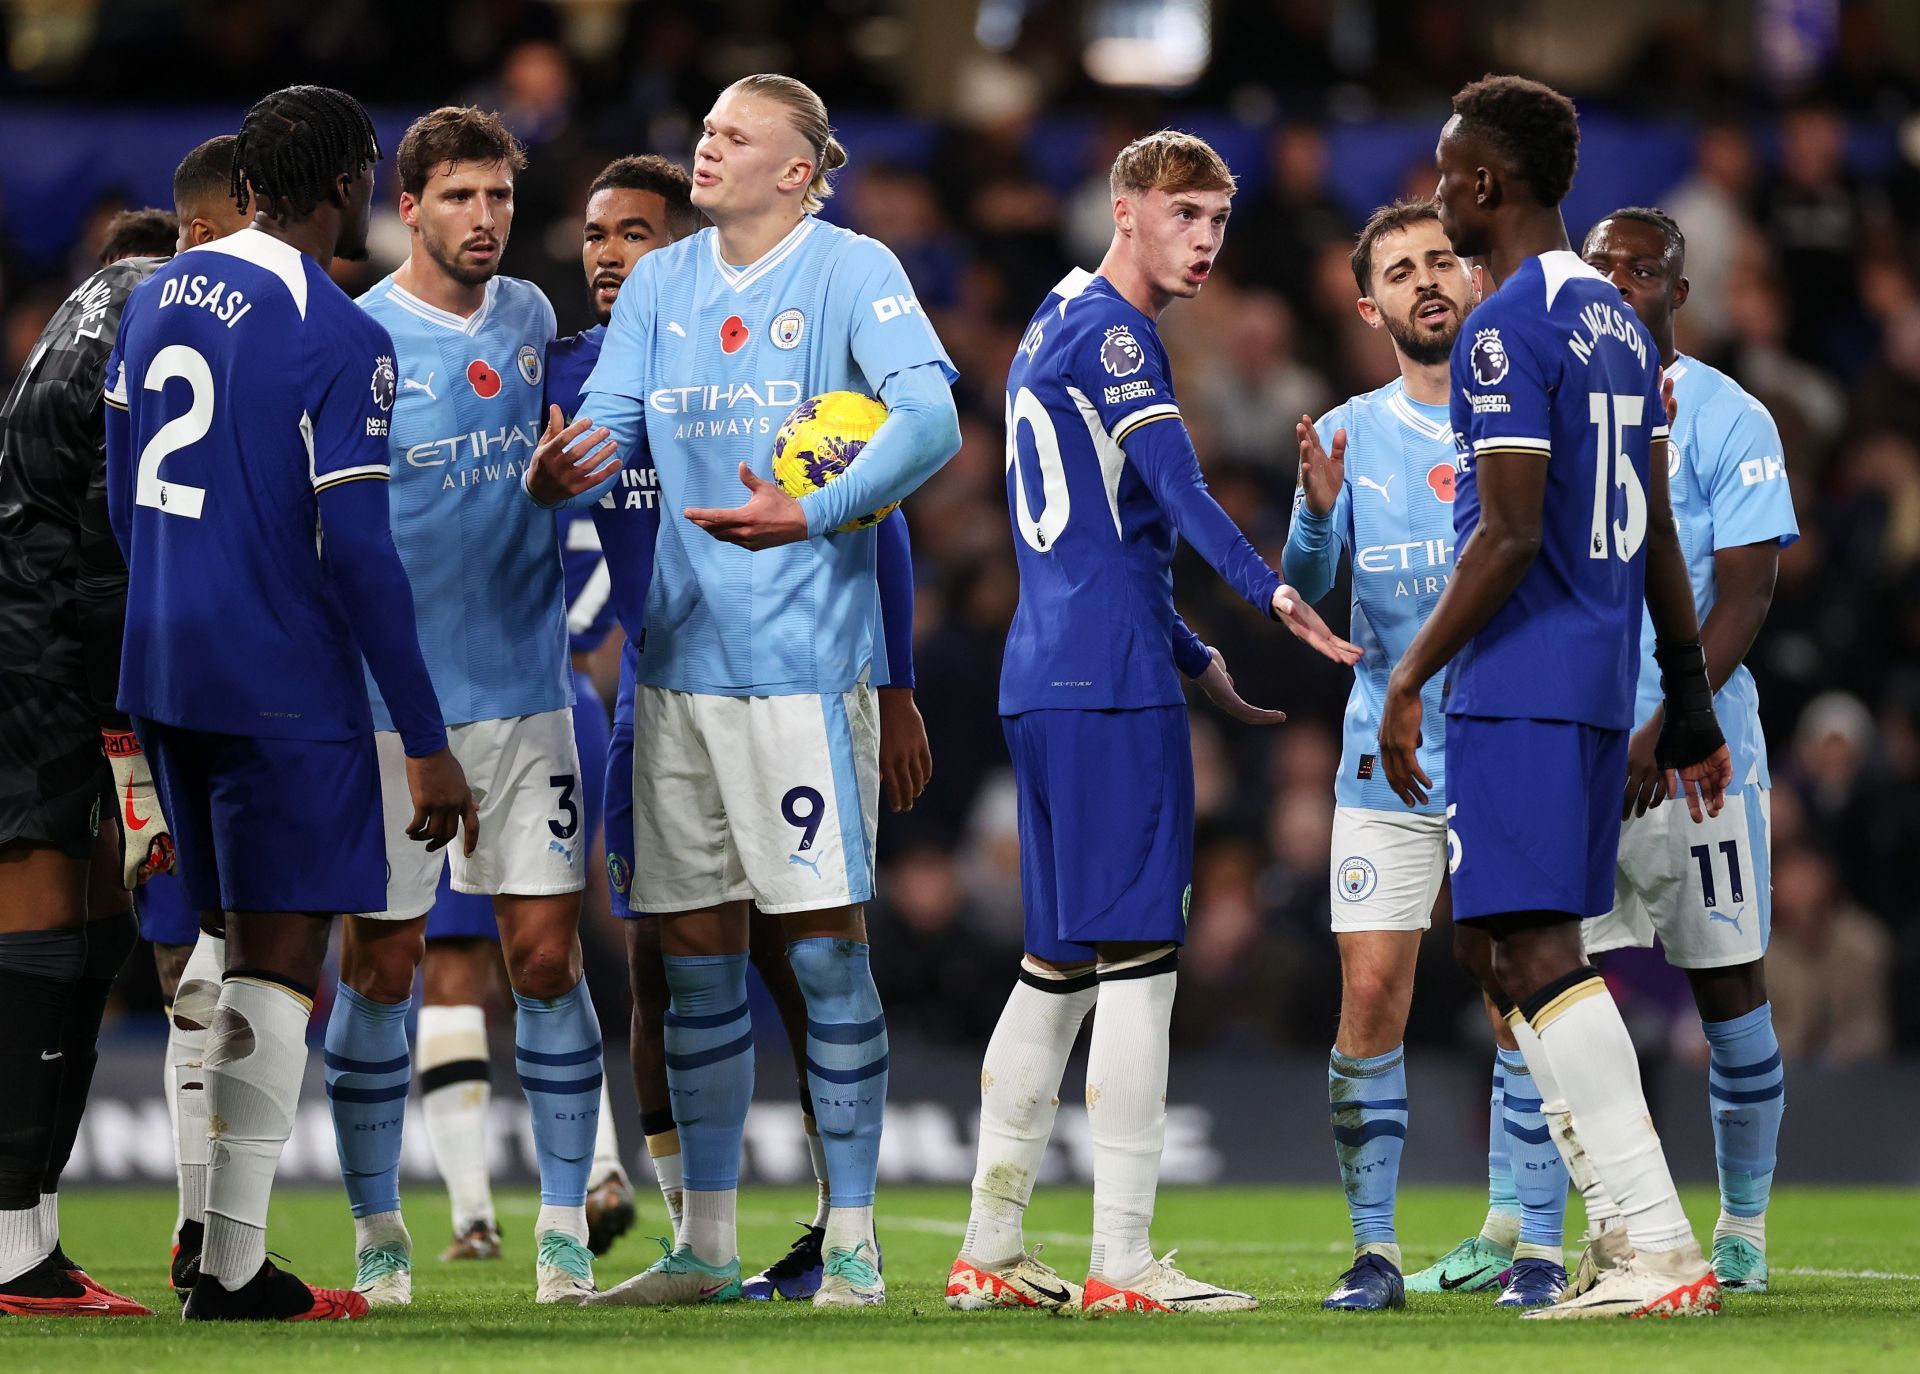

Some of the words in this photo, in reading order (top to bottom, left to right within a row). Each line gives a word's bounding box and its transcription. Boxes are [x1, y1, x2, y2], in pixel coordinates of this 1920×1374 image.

[70, 270, 111, 345] ANCHEZ
[159, 275, 252, 329] DISASI
[1568, 302, 1647, 370] N.JACKSON
[649, 380, 801, 414] ETIHAD
[1103, 386, 1120, 396] No
[1120, 380, 1150, 393] room
[1121, 388, 1156, 401] racism
[136, 345, 215, 520] 2
[673, 417, 770, 440] AIRWAYS
[442, 461, 528, 490] AIRWAY
[1005, 387, 1070, 552] 0
[1589, 392, 1648, 563] 15
[548, 774, 578, 838] 3
[781, 785, 825, 851] 9
[1691, 840, 1744, 907] 11
[555, 1108, 597, 1121] CITY
[819, 1097, 872, 1107] CITY
[354, 1118, 399, 1131] CITY
[1344, 1157, 1387, 1174] CITY
[1525, 1157, 1559, 1170] CIT
